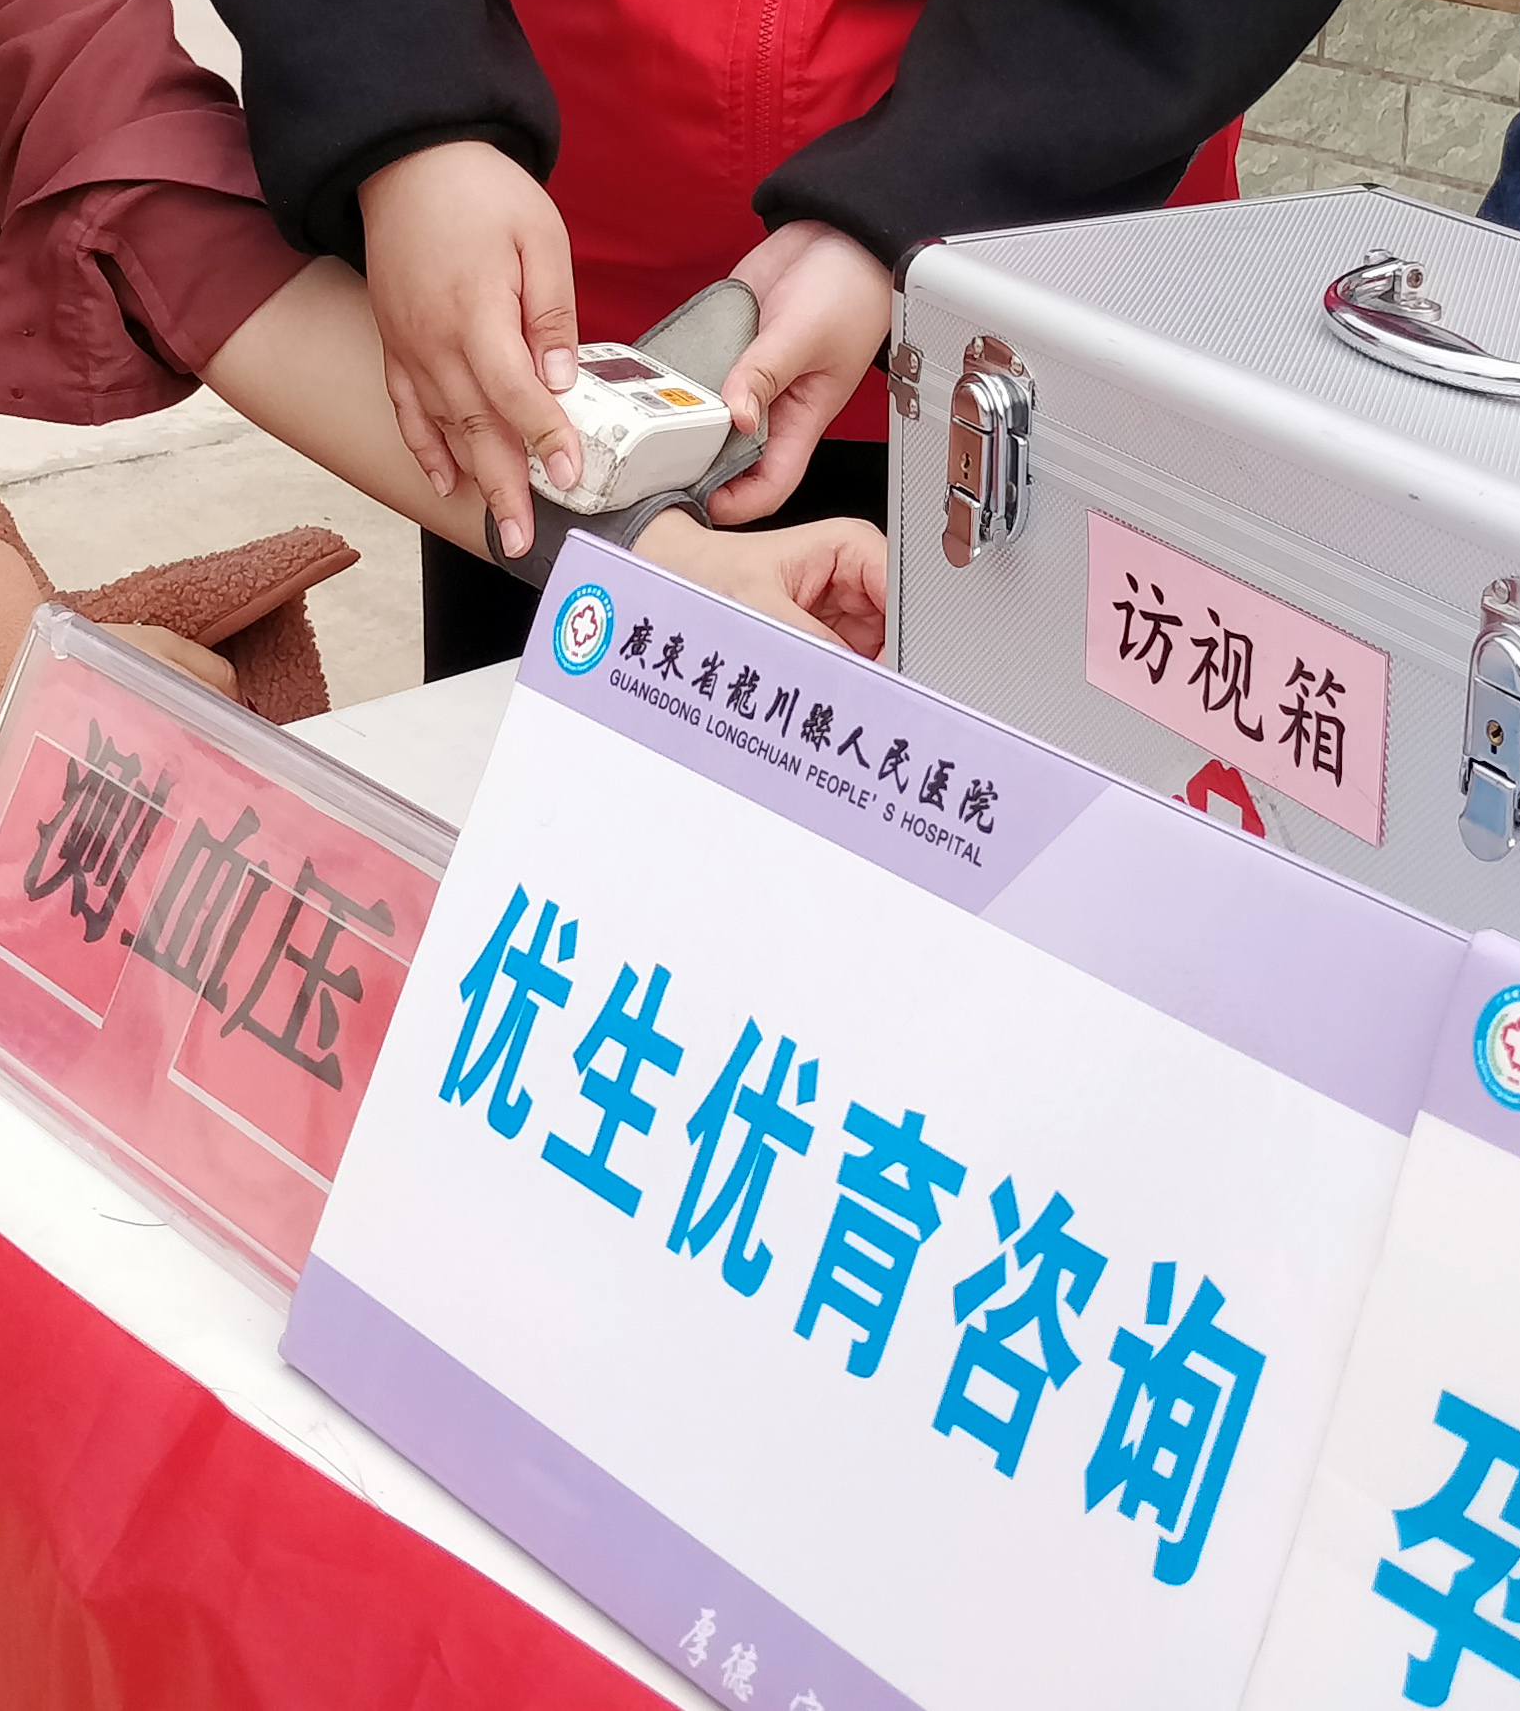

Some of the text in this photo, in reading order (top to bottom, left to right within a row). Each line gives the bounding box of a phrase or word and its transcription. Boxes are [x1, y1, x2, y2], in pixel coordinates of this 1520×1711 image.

[609, 667, 702, 727] GUANGDONG
[705, 716, 801, 777] LONGCHUAN
[900, 812, 984, 868] HOSPITAL
[1111, 571, 1349, 789] 访视箱
[24, 718, 397, 1091] 测血压
[437, 882, 1268, 1588] 优生优育咨询
